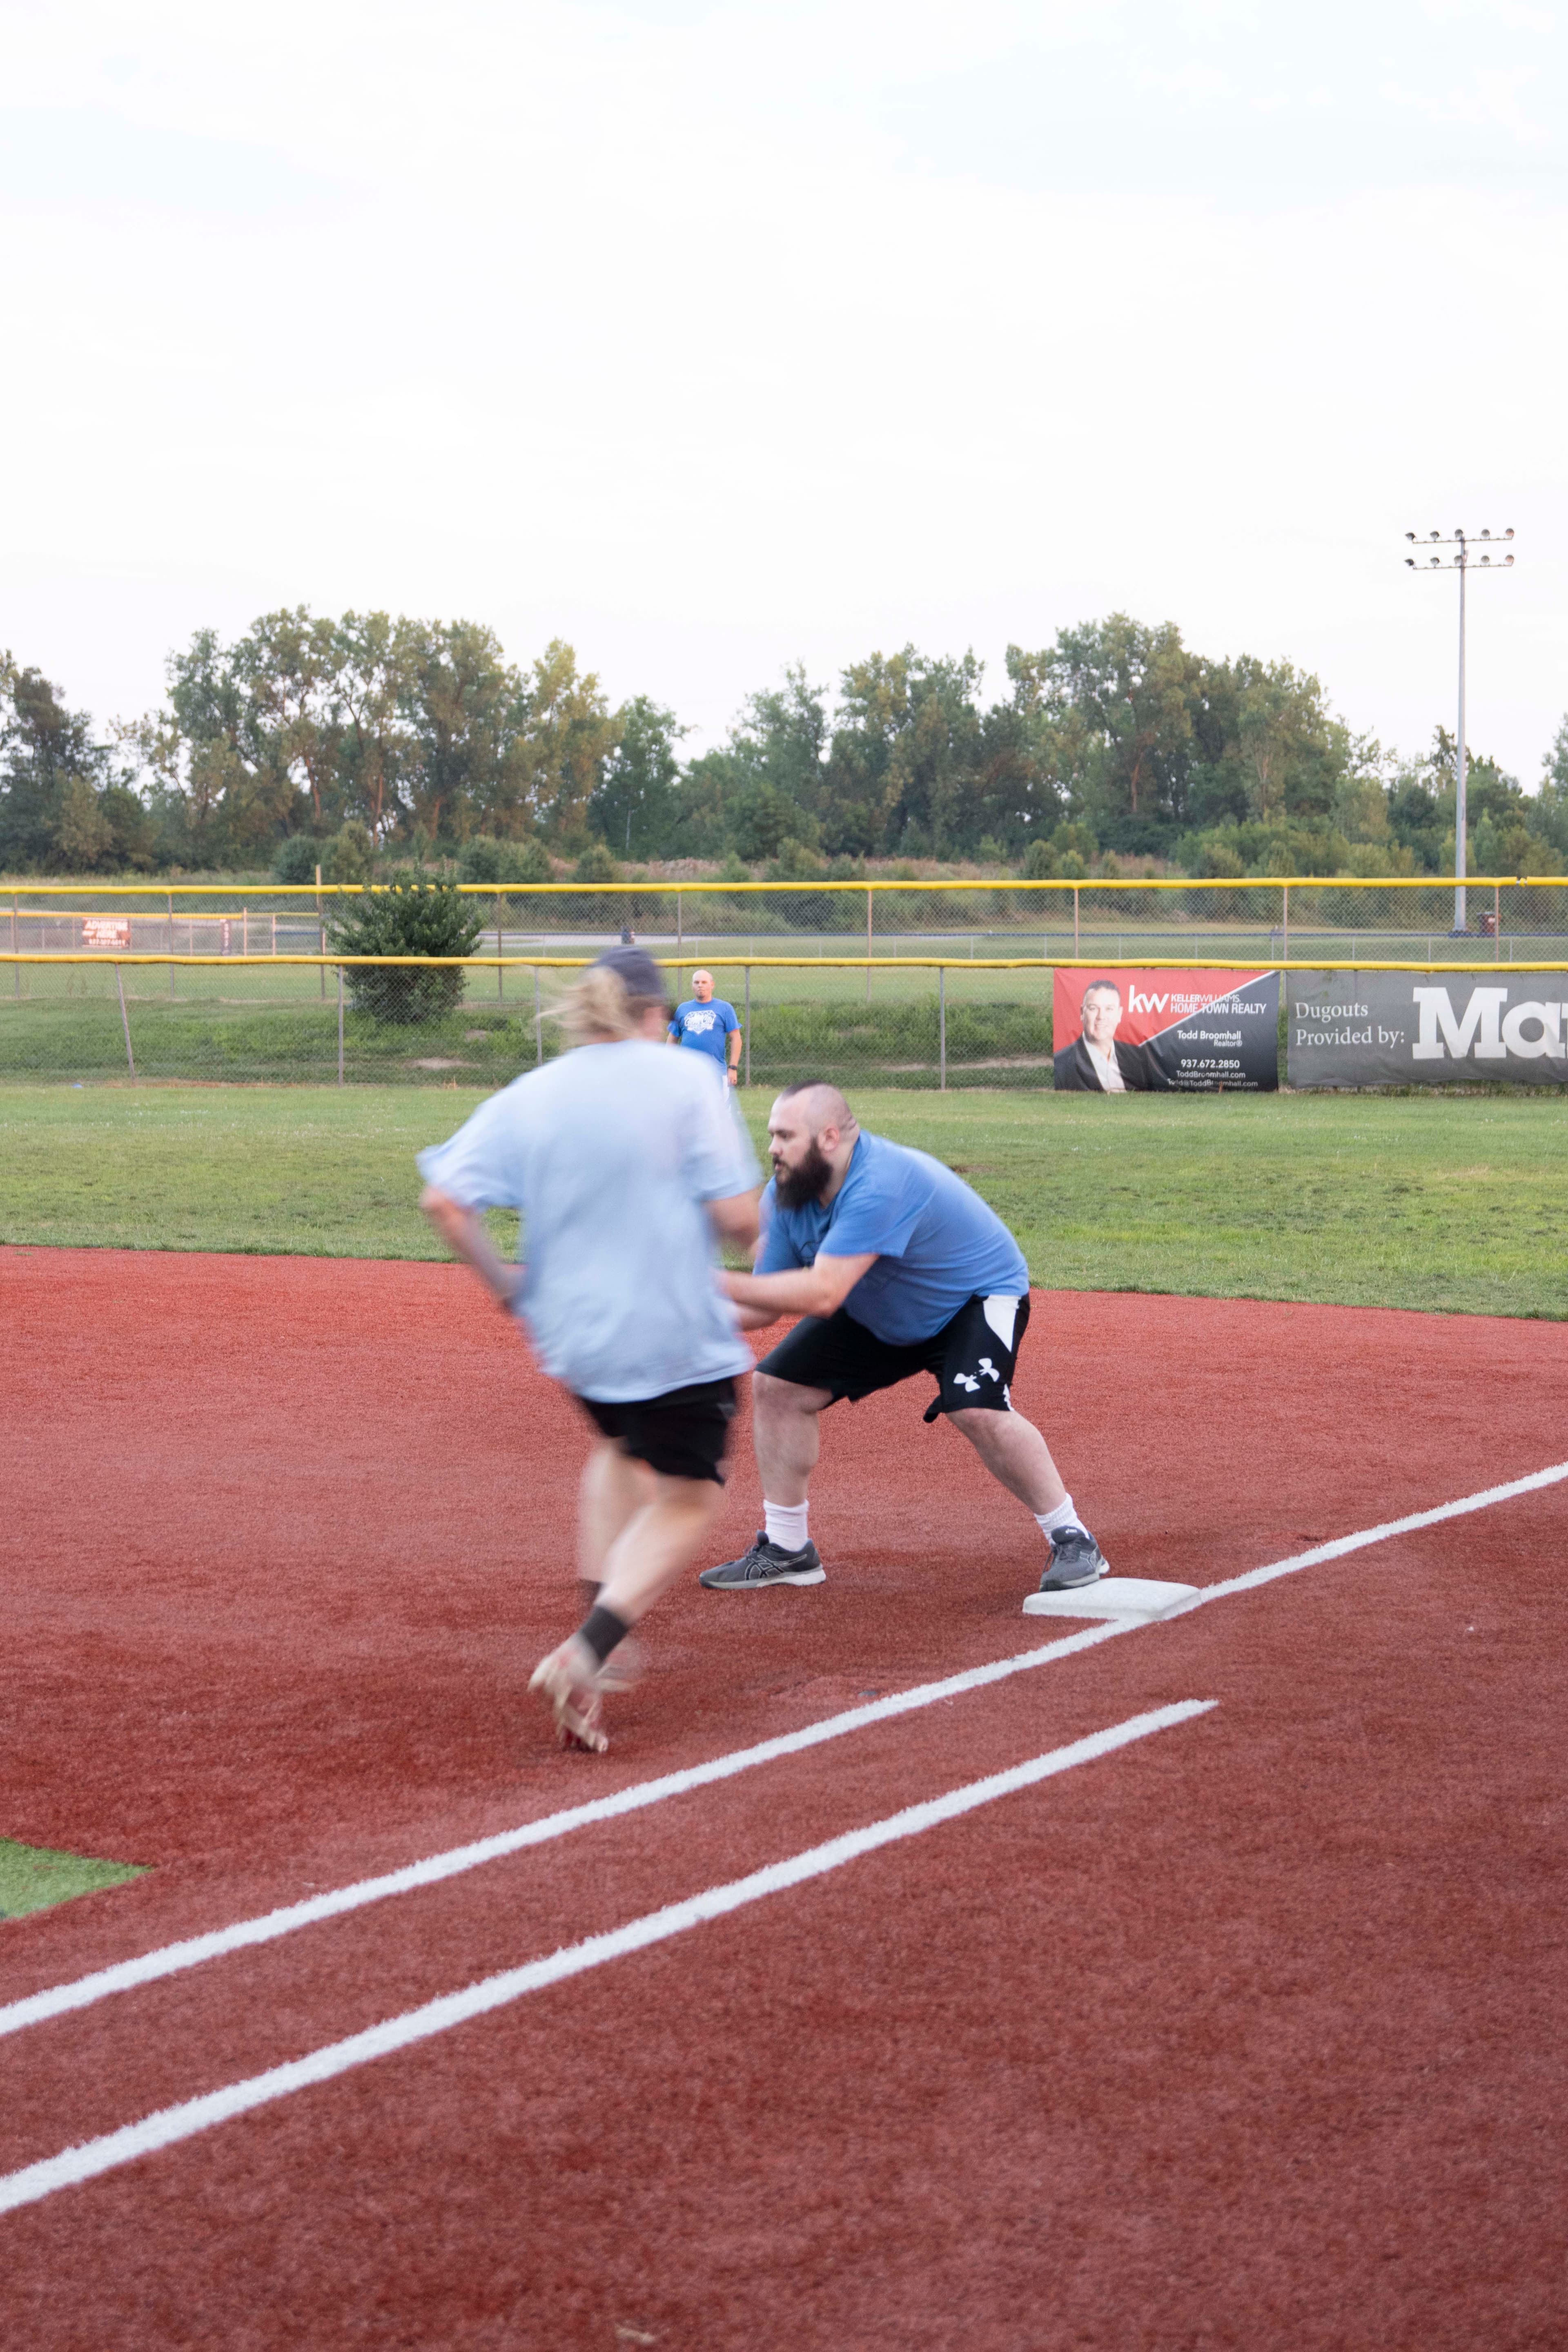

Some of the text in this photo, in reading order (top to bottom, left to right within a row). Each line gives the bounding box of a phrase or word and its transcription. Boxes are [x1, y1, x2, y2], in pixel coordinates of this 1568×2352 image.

[1128, 984, 1169, 1013] kw
[1170, 1002, 1267, 1014] HOME TOWN REALTY
[1295, 1002, 1368, 1023] Dugouts
[1412, 987, 1568, 1059] Ma
[1177, 1030, 1241, 1040] Todd Broomhall
[1296, 1026, 1404, 1049] Provided by:
[1181, 1059, 1240, 1068] 937.672.2850
[1176, 1070, 1246, 1078] ToddBroomhall.com
